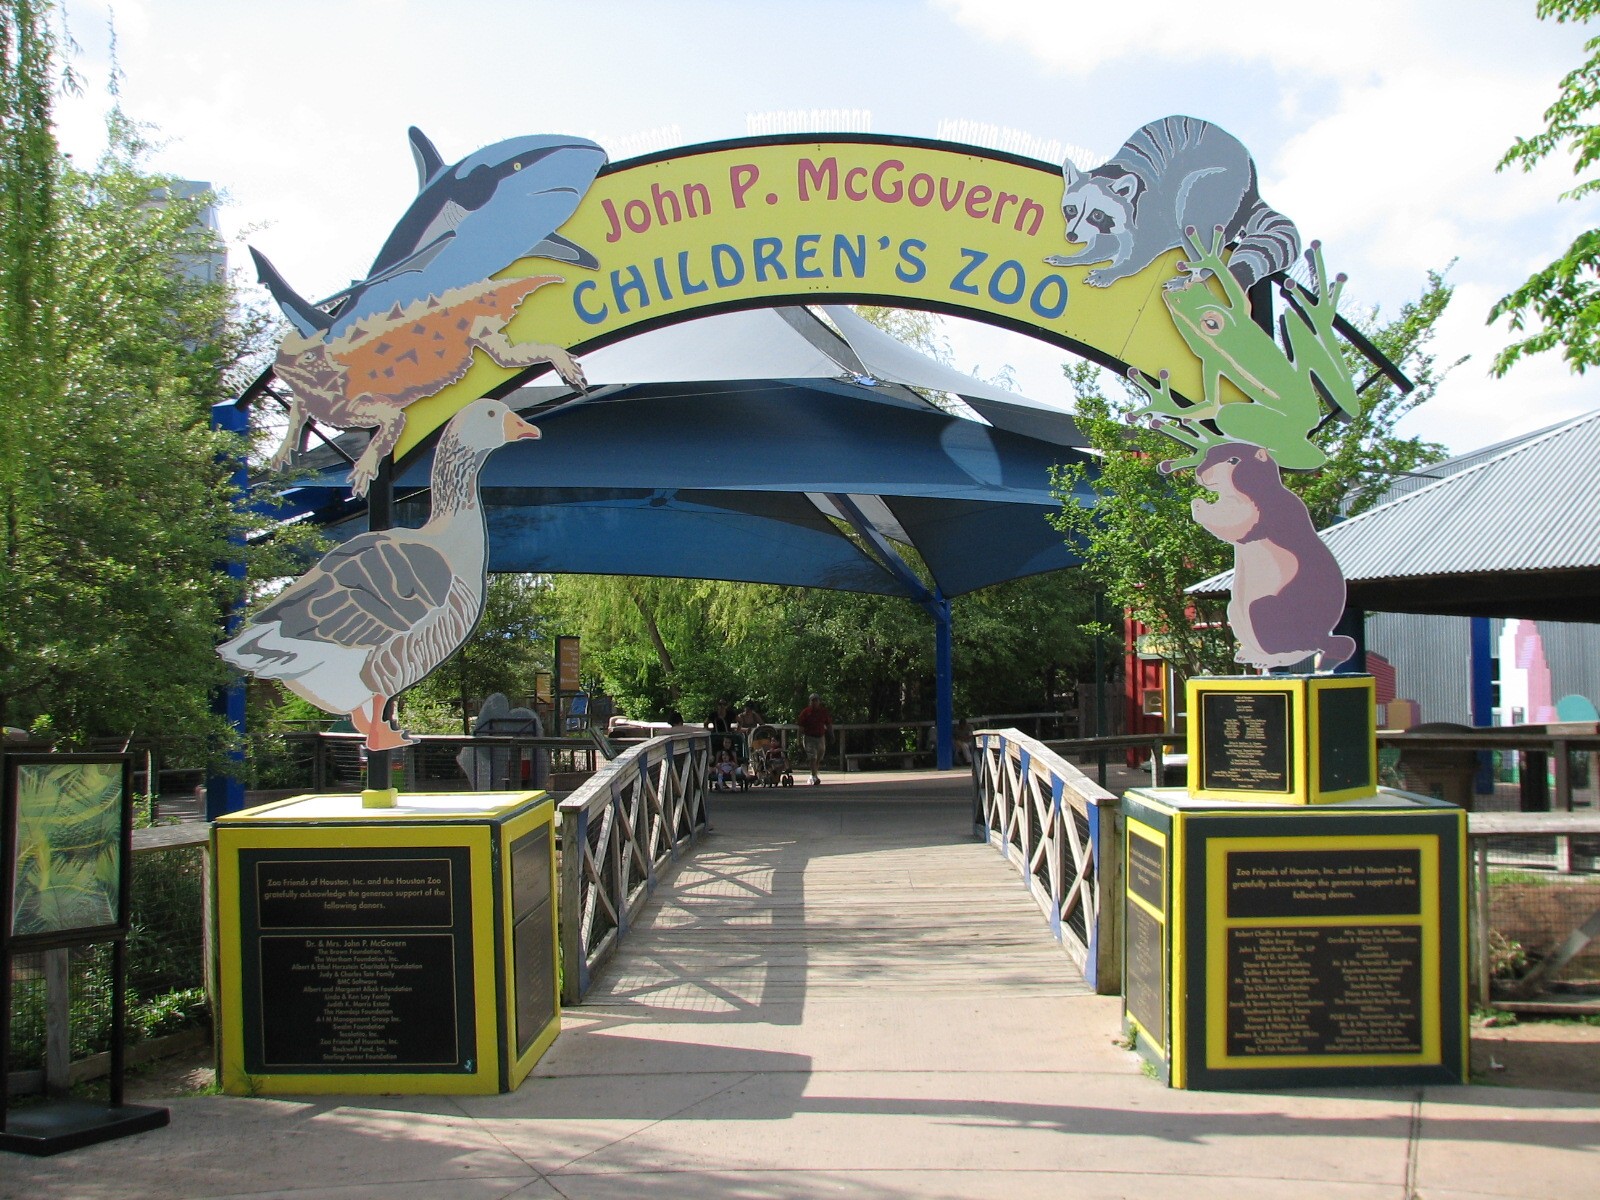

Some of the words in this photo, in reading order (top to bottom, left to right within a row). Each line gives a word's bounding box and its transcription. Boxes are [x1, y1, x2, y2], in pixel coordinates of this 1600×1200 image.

[601, 182, 712, 243] John
[729, 163, 778, 209] P.
[797, 157, 1045, 236] McGovern
[573, 234, 927, 325] CHILDREN'S
[949, 247, 1068, 319] ZOO
[1236, 868, 1250, 876] Zoo
[1280, 867, 1288, 875] of
[1290, 867, 1320, 876] Houston,
[1338, 866, 1352, 874] and
[1354, 866, 1365, 874] the
[1366, 866, 1396, 874] Houston
[267, 878, 281, 886] Zoo
[284, 878, 309, 886] Friends
[311, 878, 318, 886] of
[320, 878, 350, 886] Houston,
[367, 877, 381, 885] and
[383, 877, 394, 885] the
[396, 877, 425, 885] Houston
[1232, 880, 1266, 889] gratefully
[1269, 879, 1316, 889] acknowledge
[1331, 880, 1364, 888] generous
[1366, 878, 1394, 887] support
[1404, 877, 1416, 885] the
[264, 890, 298, 899] gratefully
[299, 890, 346, 899] acknowledge
[362, 890, 394, 898] generous
[396, 888, 423, 898] support
[425, 888, 432, 896] of
[434, 888, 445, 896] the
[1293, 891, 1327, 901] following
[324, 902, 357, 911] following
